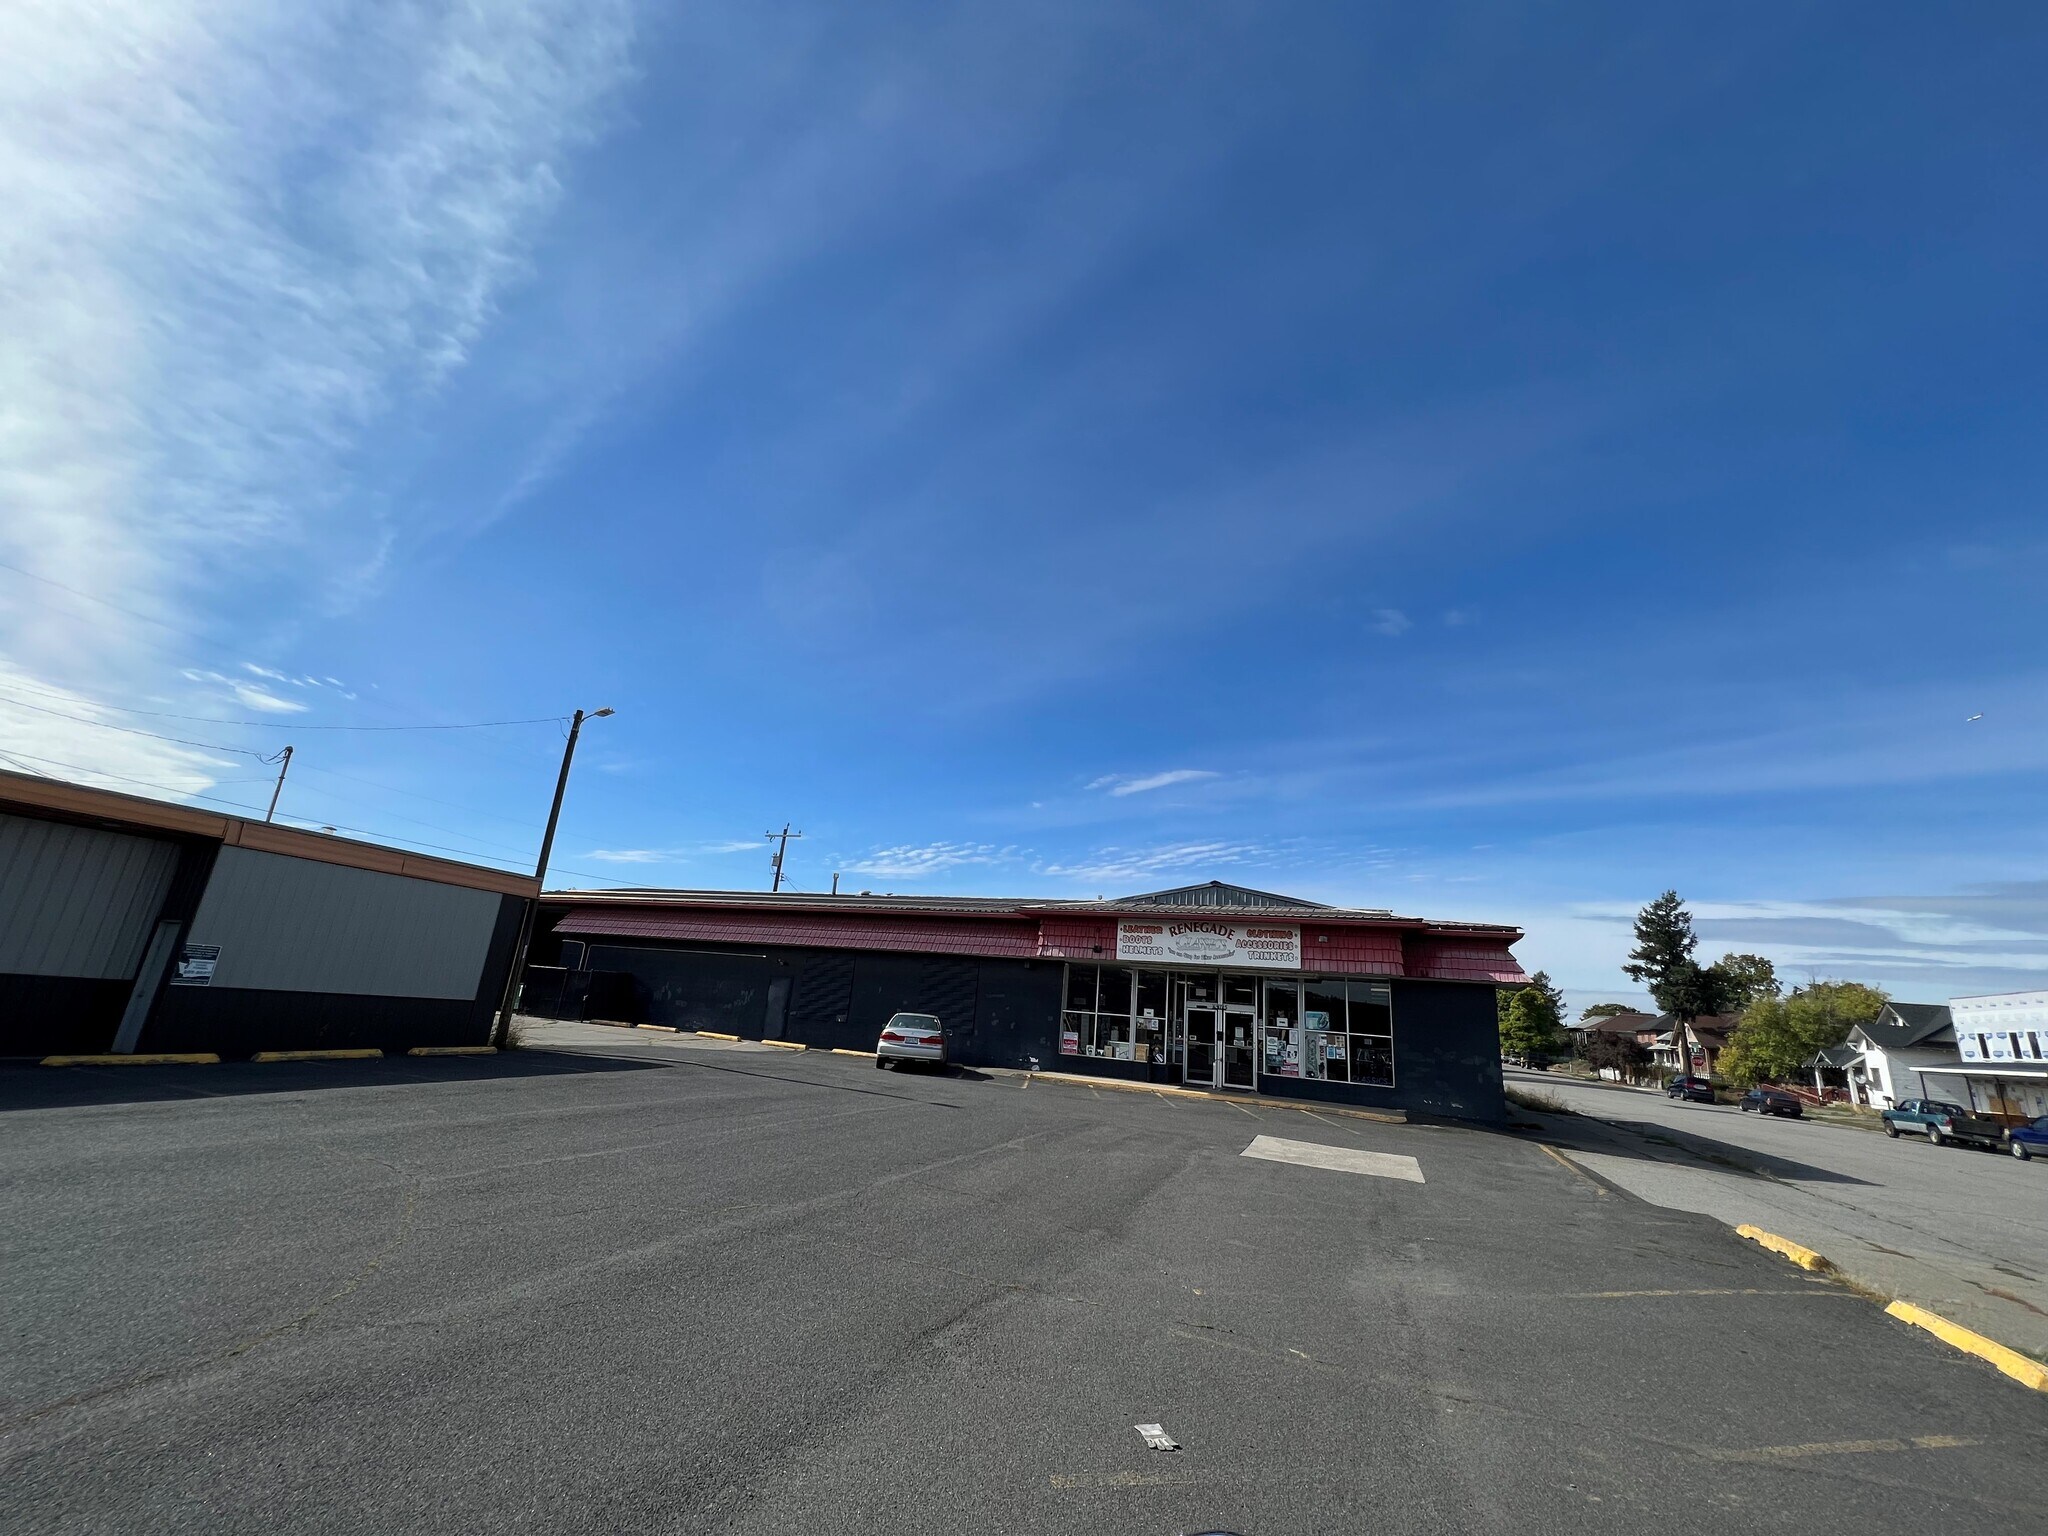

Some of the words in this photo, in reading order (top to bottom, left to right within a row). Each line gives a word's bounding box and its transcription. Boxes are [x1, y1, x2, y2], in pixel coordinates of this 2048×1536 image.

[1122, 924, 1163, 934] LEATHER
[1168, 922, 1236, 941] RENEGADE
[1246, 928, 1294, 939] CLOTHING
[1122, 934, 1153, 945] BOOTS
[1235, 938, 1294, 951] ACCESSORIES
[1121, 944, 1164, 956] HELMETS
[1247, 950, 1295, 962] TRINKETS
